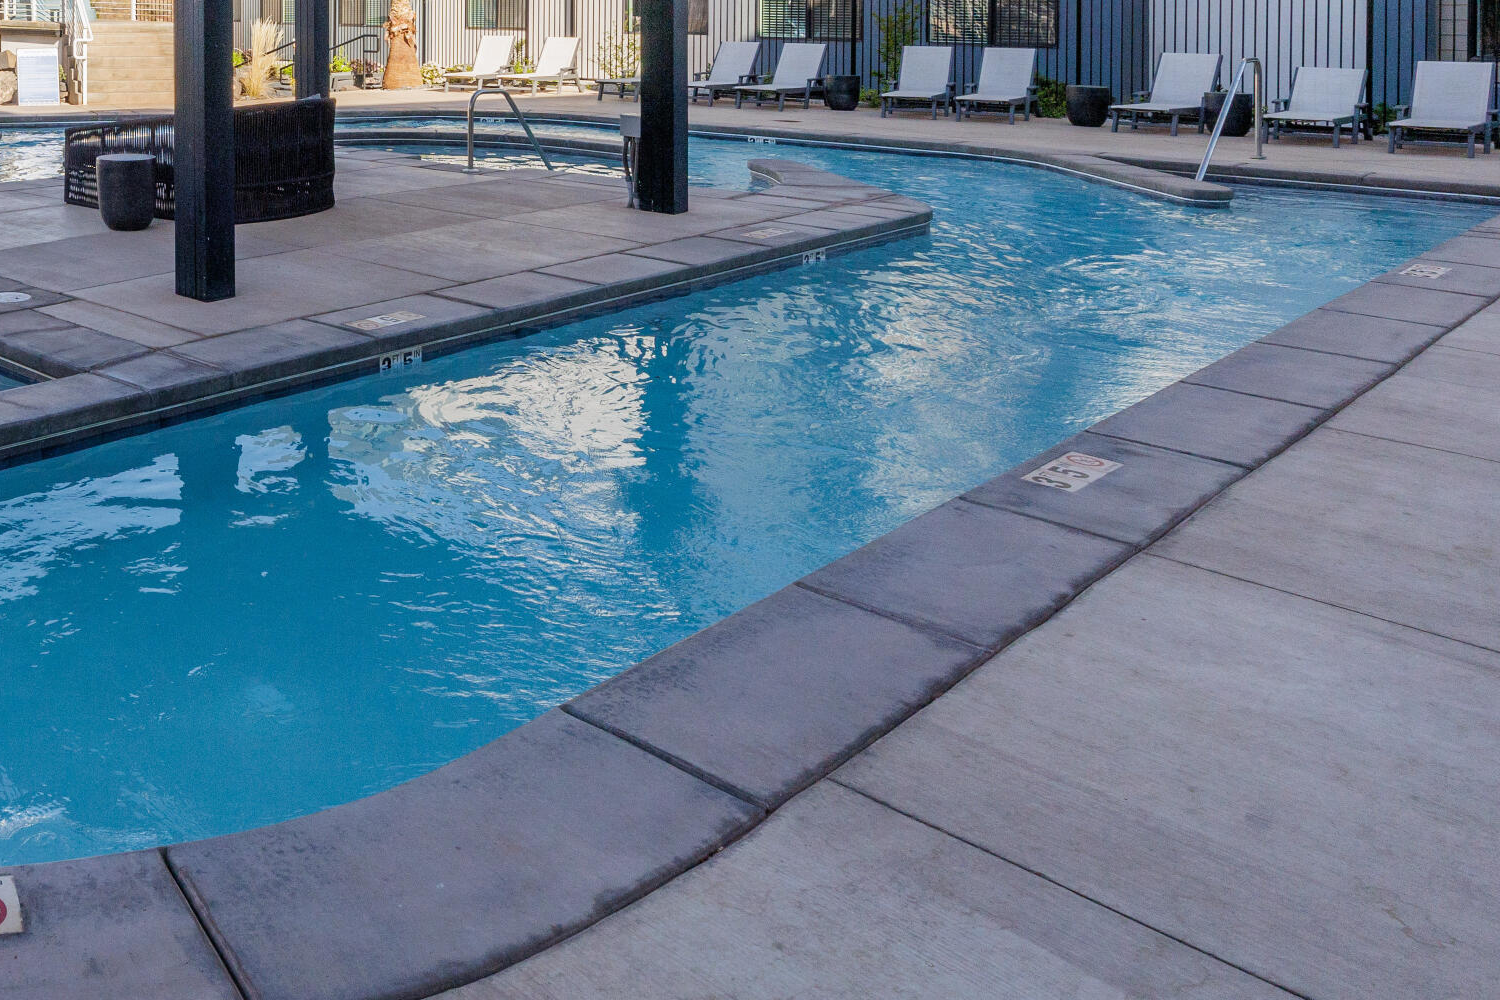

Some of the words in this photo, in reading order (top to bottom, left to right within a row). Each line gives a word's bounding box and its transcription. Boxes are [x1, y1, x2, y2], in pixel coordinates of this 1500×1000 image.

[413, 349, 421, 358] IN
[1048, 466, 1090, 479] 5
[1032, 476, 1072, 489] 3
